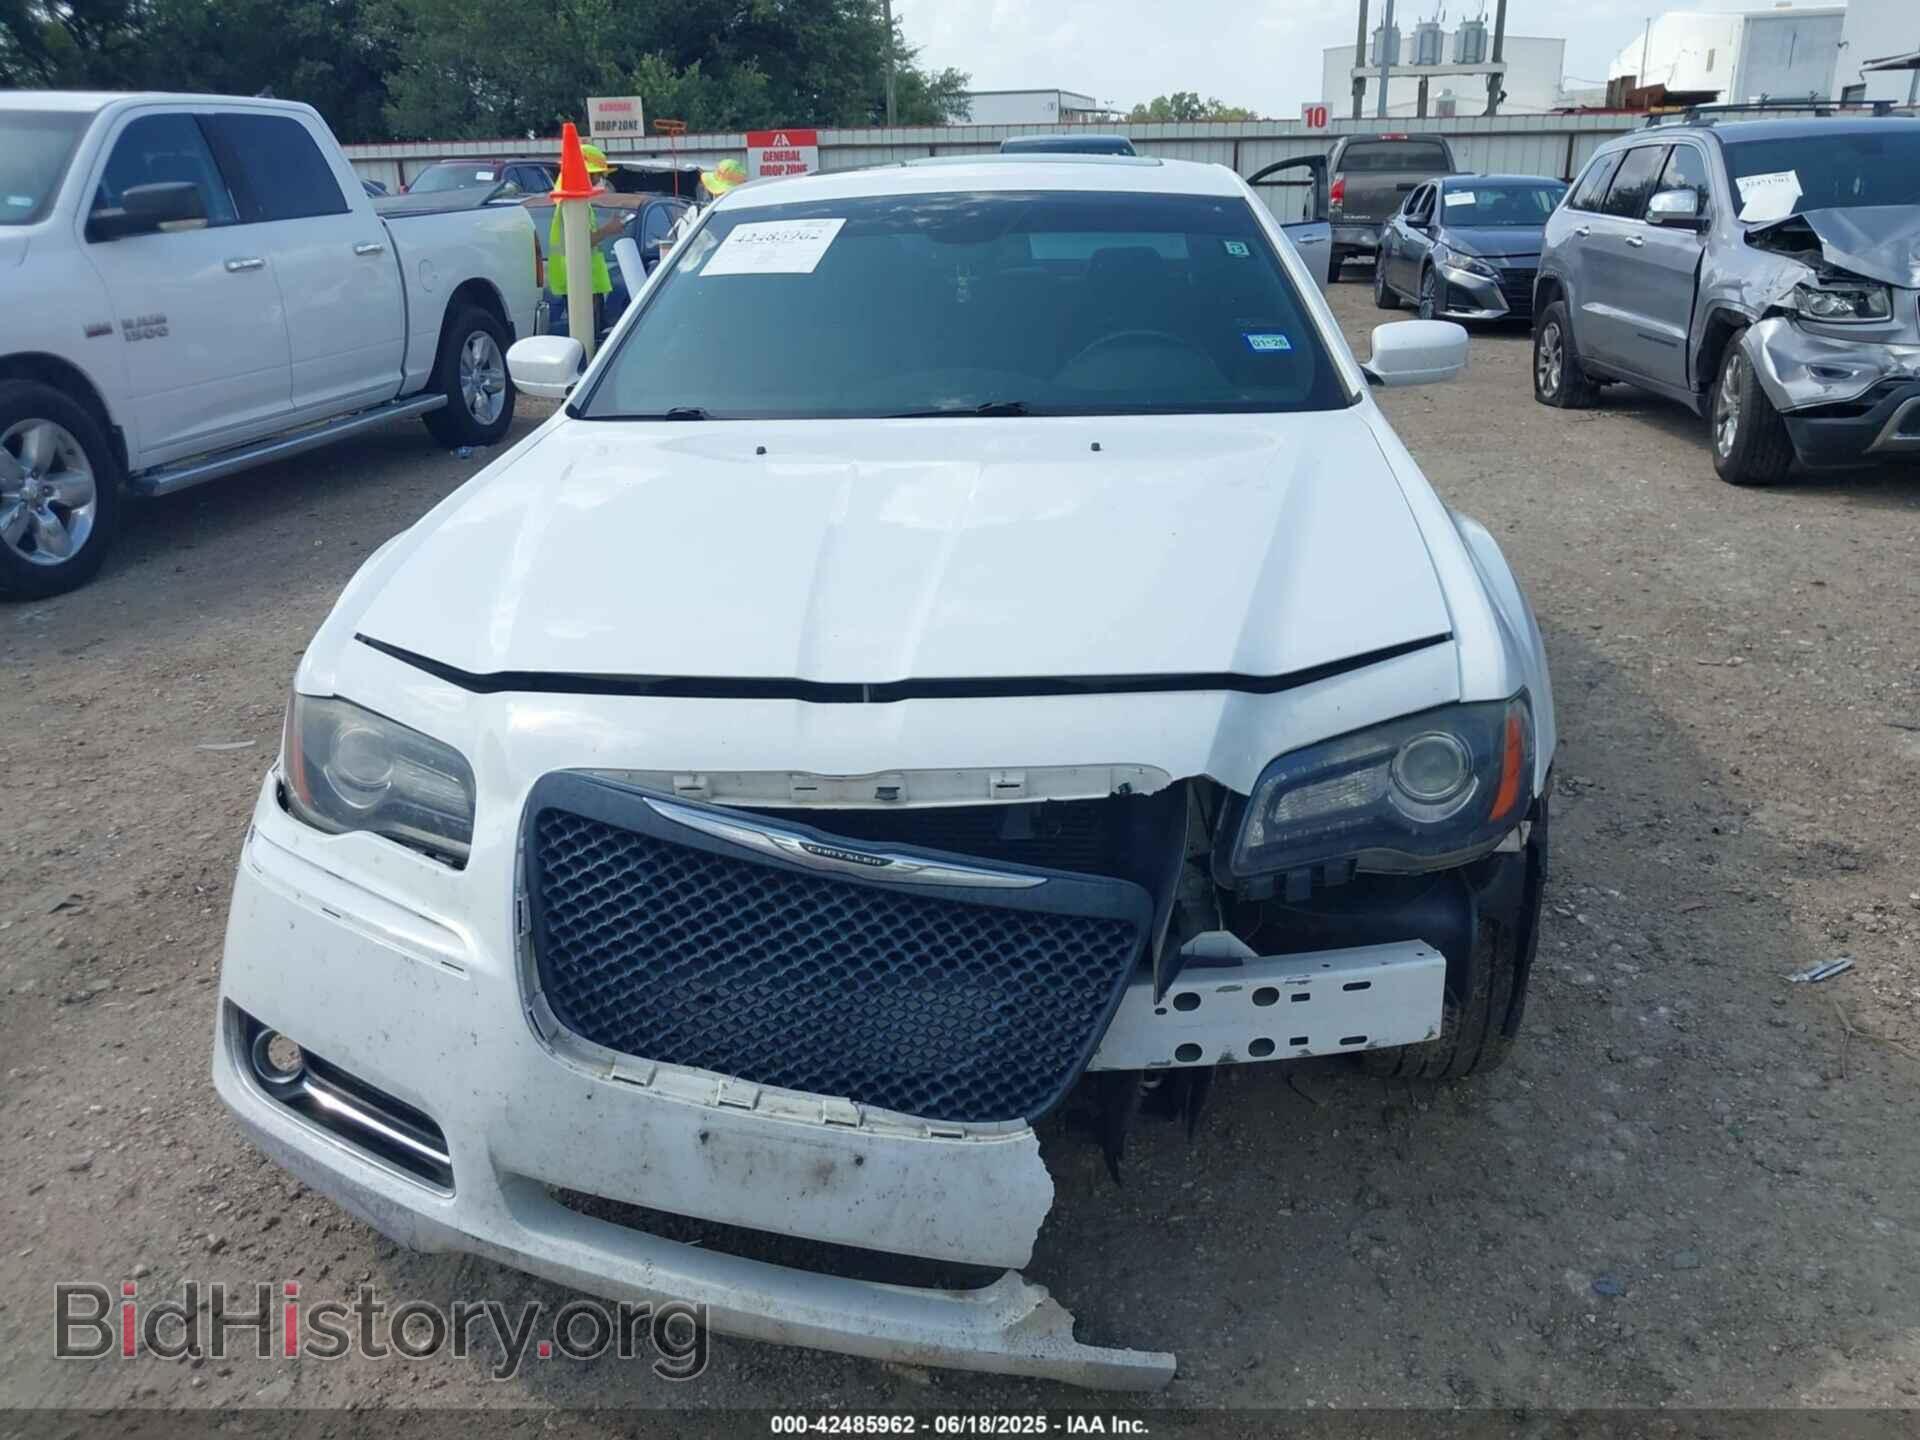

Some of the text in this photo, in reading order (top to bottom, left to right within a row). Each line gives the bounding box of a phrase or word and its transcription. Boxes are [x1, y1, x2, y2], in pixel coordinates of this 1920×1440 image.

[1304, 106, 1327, 128] 10
[618, 120, 638, 130] ZONE
[763, 150, 800, 162] GENERAL
[760, 164, 784, 176] DROP
[808, 845, 881, 866] CHRYSLER
